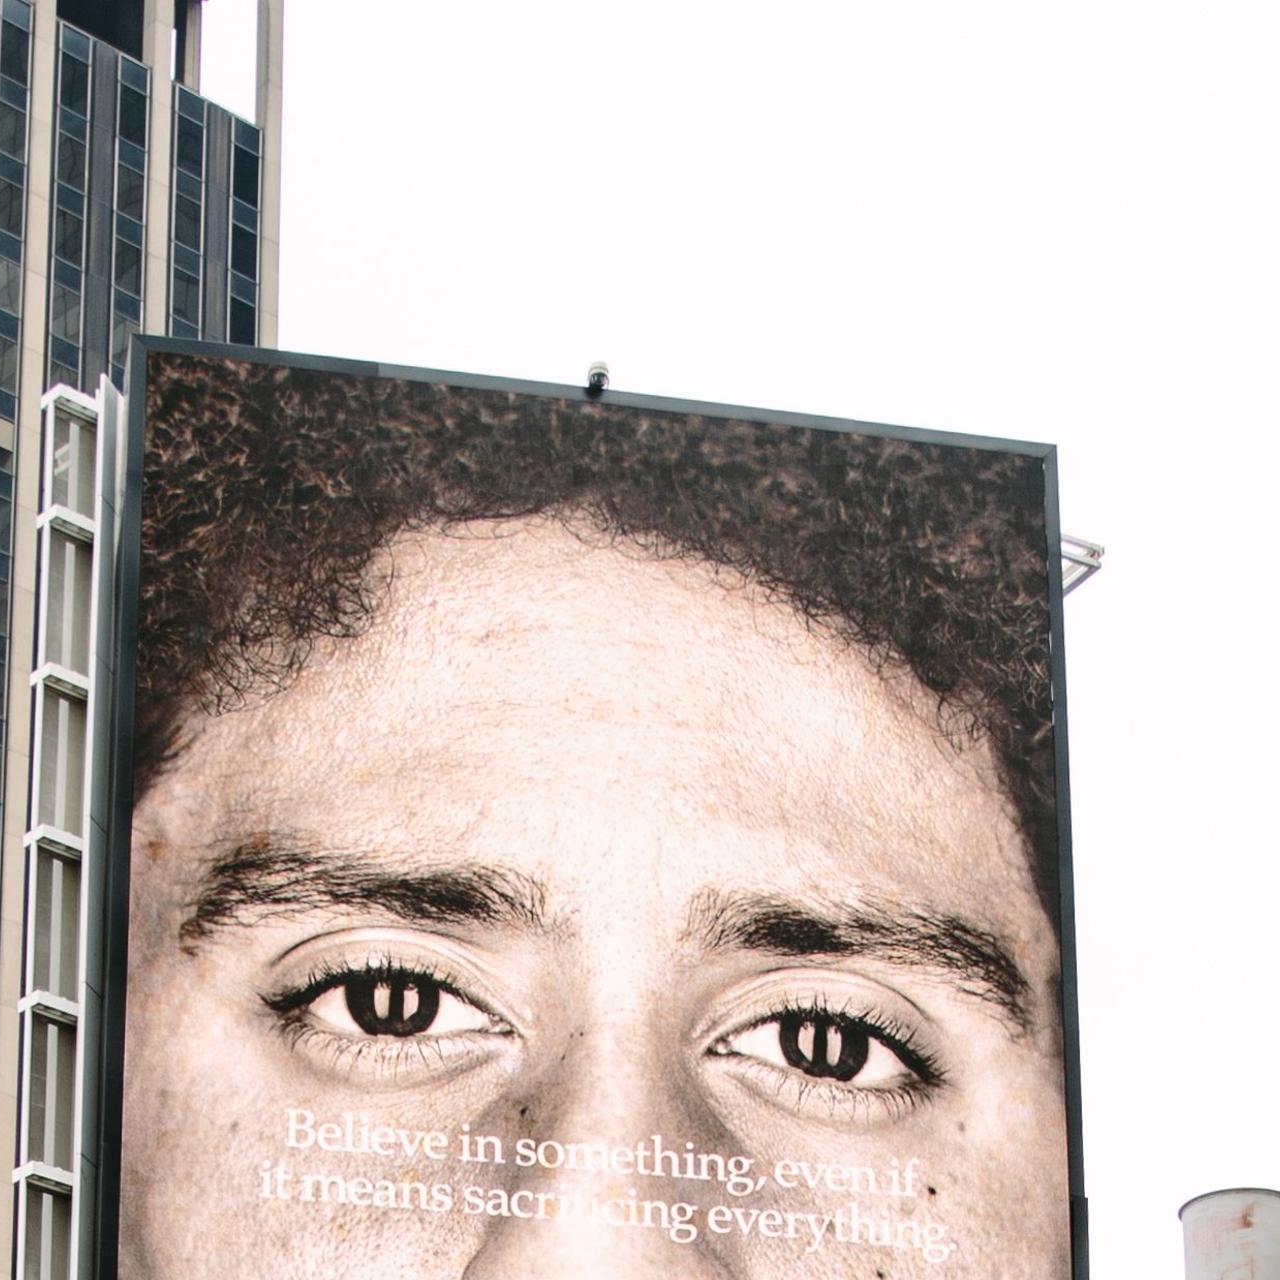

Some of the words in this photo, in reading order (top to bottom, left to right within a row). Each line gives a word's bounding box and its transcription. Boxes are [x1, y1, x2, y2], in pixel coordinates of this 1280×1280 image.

[285, 1108, 448, 1161] Believe
[460, 1124, 504, 1165] in
[515, 1134, 767, 1193] something,
[776, 1161, 884, 1194] even
[890, 1156, 919, 1199] if
[259, 1159, 294, 1200] it
[303, 1170, 453, 1215] means
[707, 1195, 958, 1259] everything.
